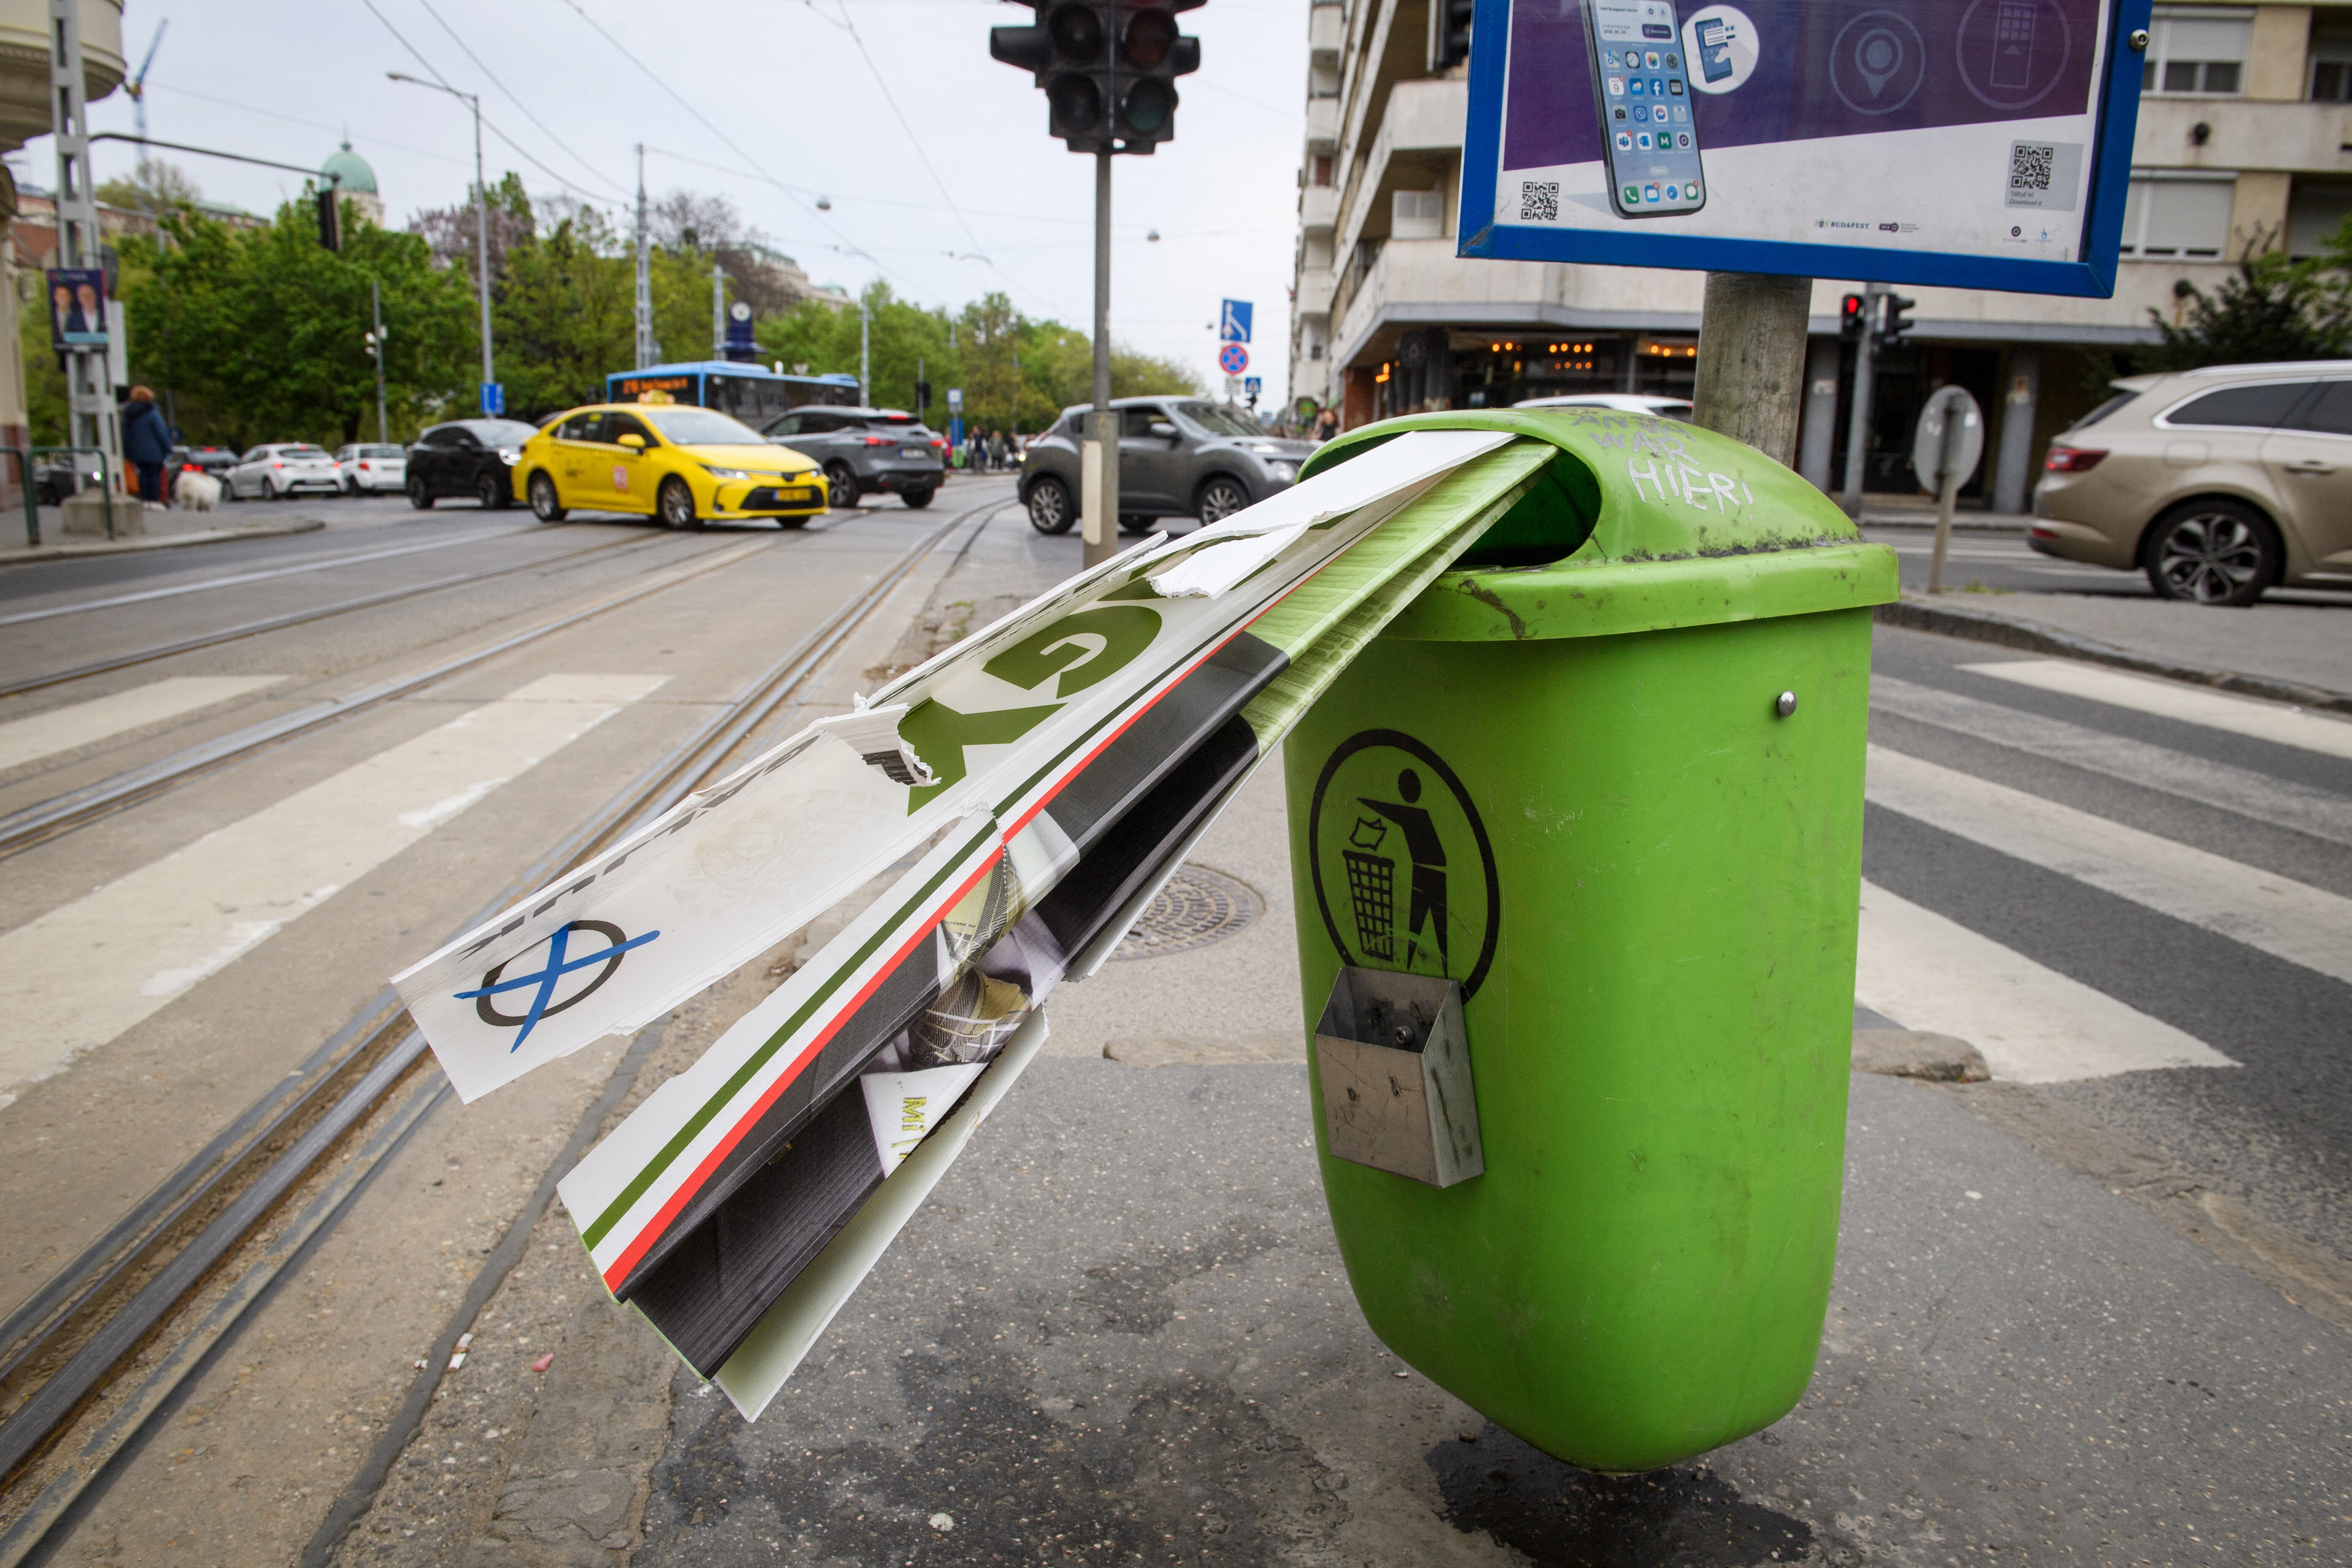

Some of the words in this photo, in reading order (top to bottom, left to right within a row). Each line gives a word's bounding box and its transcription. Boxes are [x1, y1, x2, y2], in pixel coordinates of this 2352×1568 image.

[1831, 221, 1870, 229] BUDAPEST
[1589, 431, 1699, 465] WAR
[1628, 457, 1753, 520] HIER!
